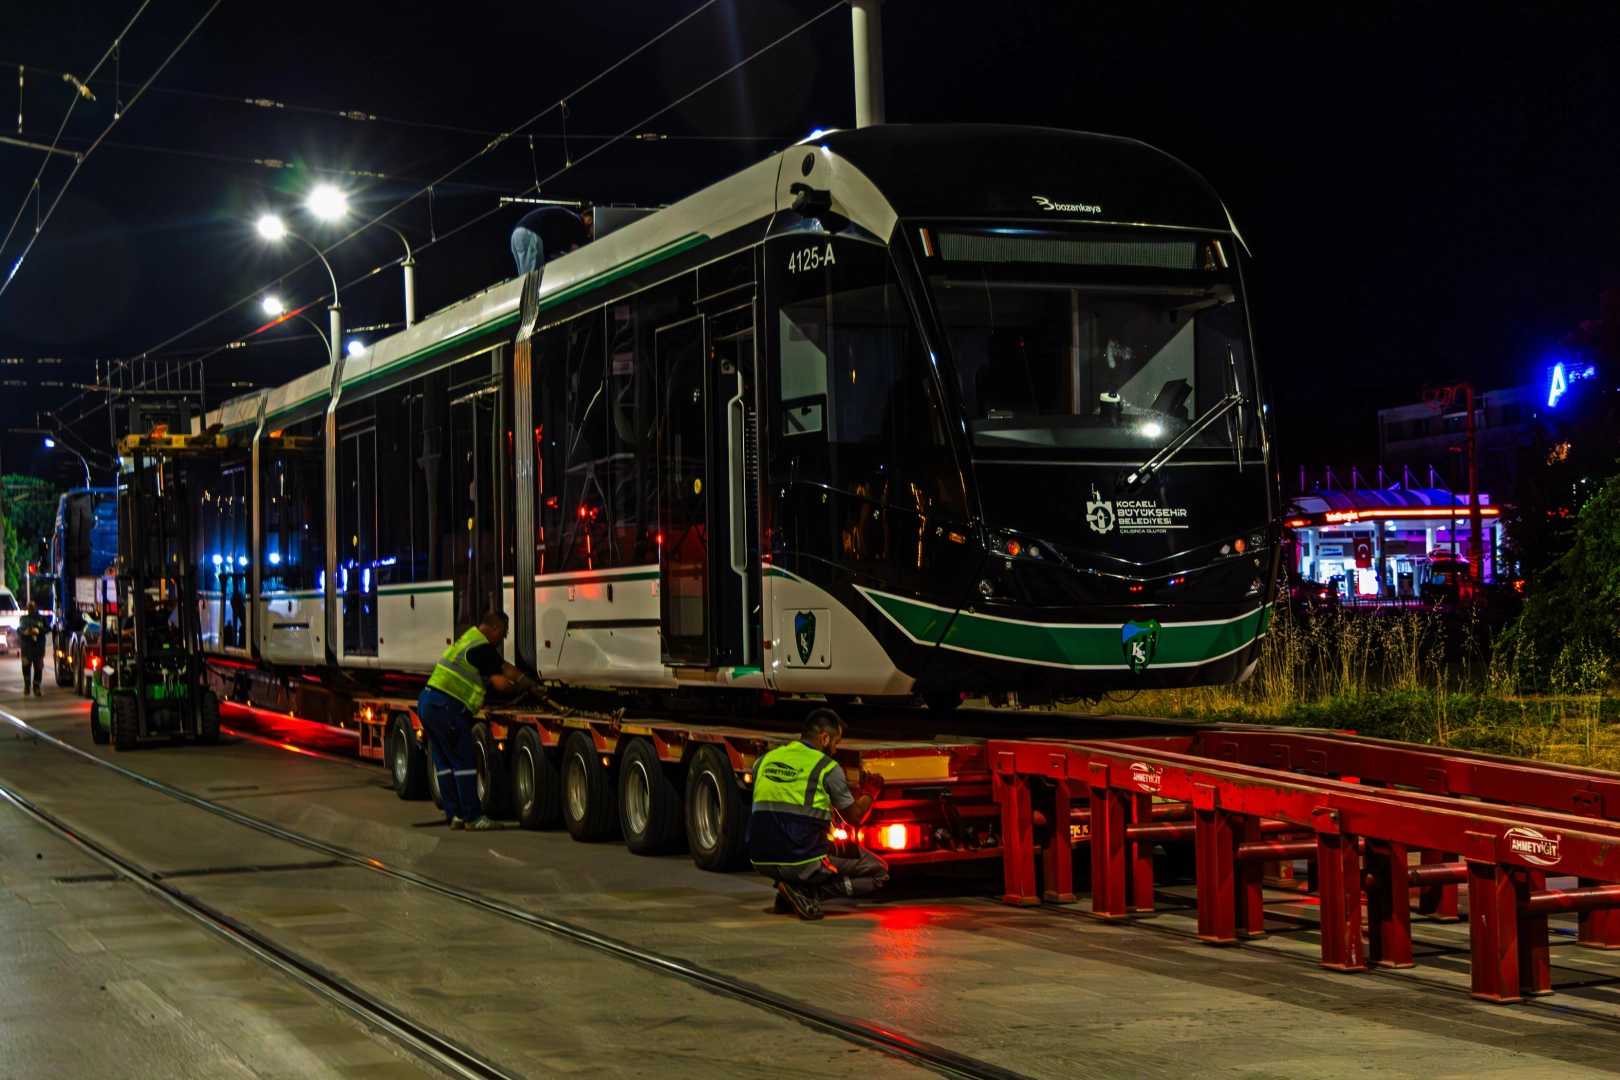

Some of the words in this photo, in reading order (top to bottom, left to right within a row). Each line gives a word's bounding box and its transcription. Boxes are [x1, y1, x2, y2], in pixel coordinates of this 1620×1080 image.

[1054, 202, 1101, 214] bozankaya
[788, 243, 836, 274] 4125-A
[1117, 508, 1187, 518] BÜYÜKŞEHİR
[1118, 517, 1172, 525] BELEDİYESİ
